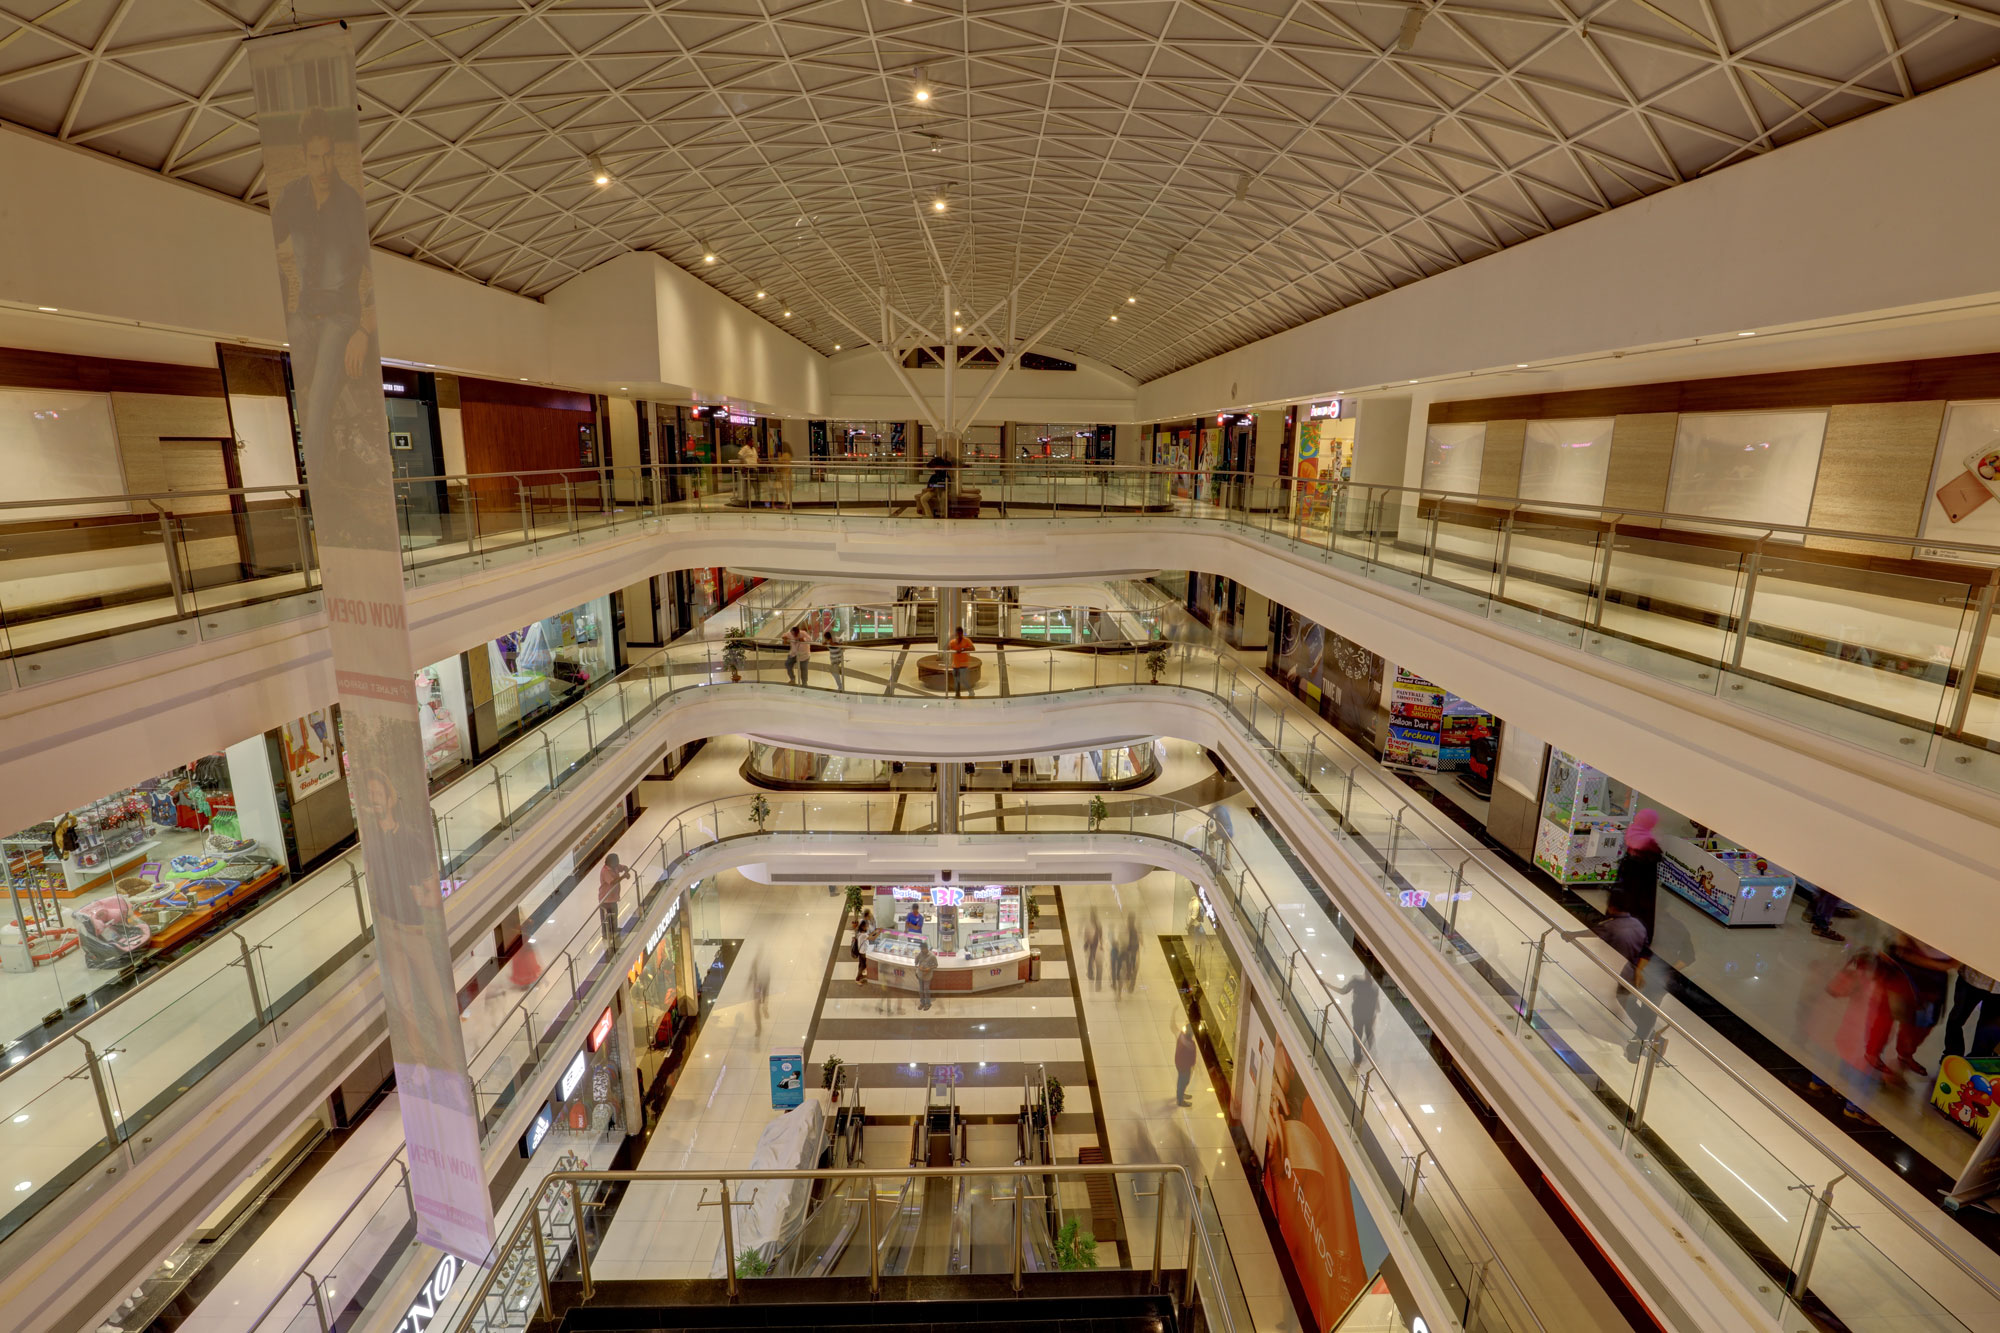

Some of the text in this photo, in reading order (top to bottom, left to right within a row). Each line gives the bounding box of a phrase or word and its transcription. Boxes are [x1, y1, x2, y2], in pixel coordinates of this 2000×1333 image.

[1413, 704, 1441, 713] BALLOON
[1390, 714, 1429, 730] Balloon Dart
[1401, 729, 1436, 744] Archery
[931, 886, 964, 906] BR
[646, 895, 680, 955] WILDCRAFT
[1293, 1170, 1334, 1278] TRENDS
